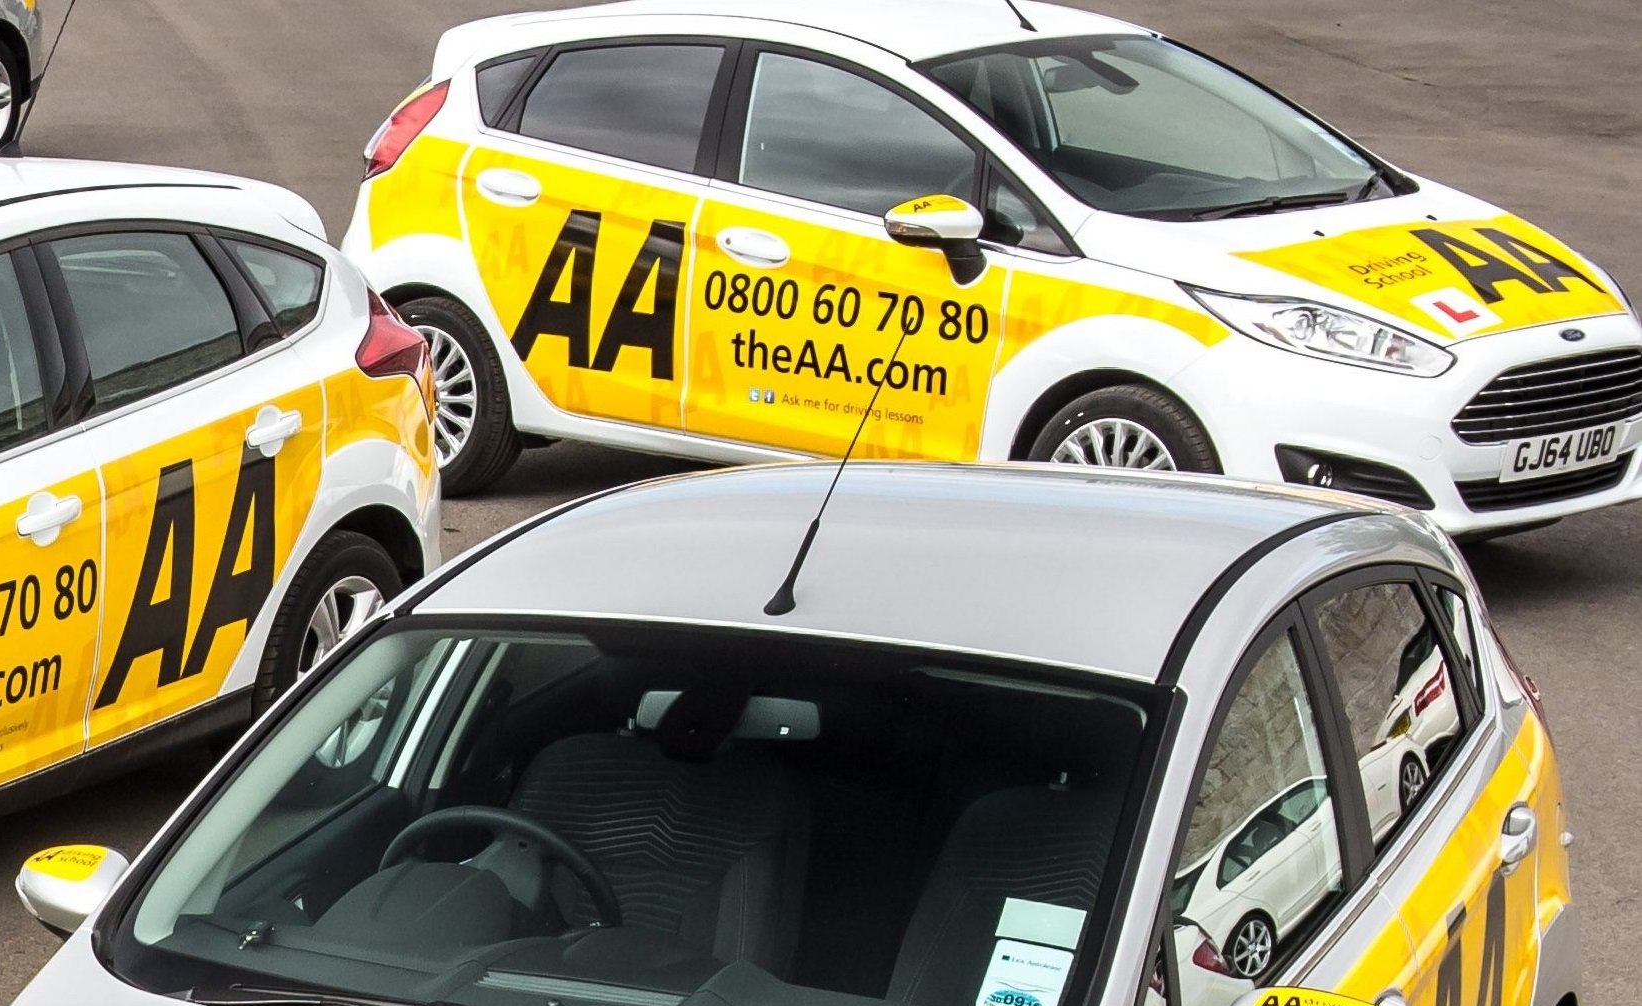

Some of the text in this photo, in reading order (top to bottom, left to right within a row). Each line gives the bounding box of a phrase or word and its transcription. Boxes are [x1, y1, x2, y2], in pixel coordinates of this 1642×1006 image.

[1348, 250, 1427, 276] Driving
[1363, 264, 1433, 289] School
[1409, 227, 1608, 305] AA
[513, 208, 686, 381] AA
[704, 270, 989, 344] 0800 60 70 80
[1432, 300, 1481, 323] L
[730, 328, 948, 396] theAA.com
[781, 393, 924, 425] Ask me for driving lessons
[1513, 425, 1616, 473] GJ64 UBO
[53, 558, 98, 620] 80
[92, 439, 277, 712] AA
